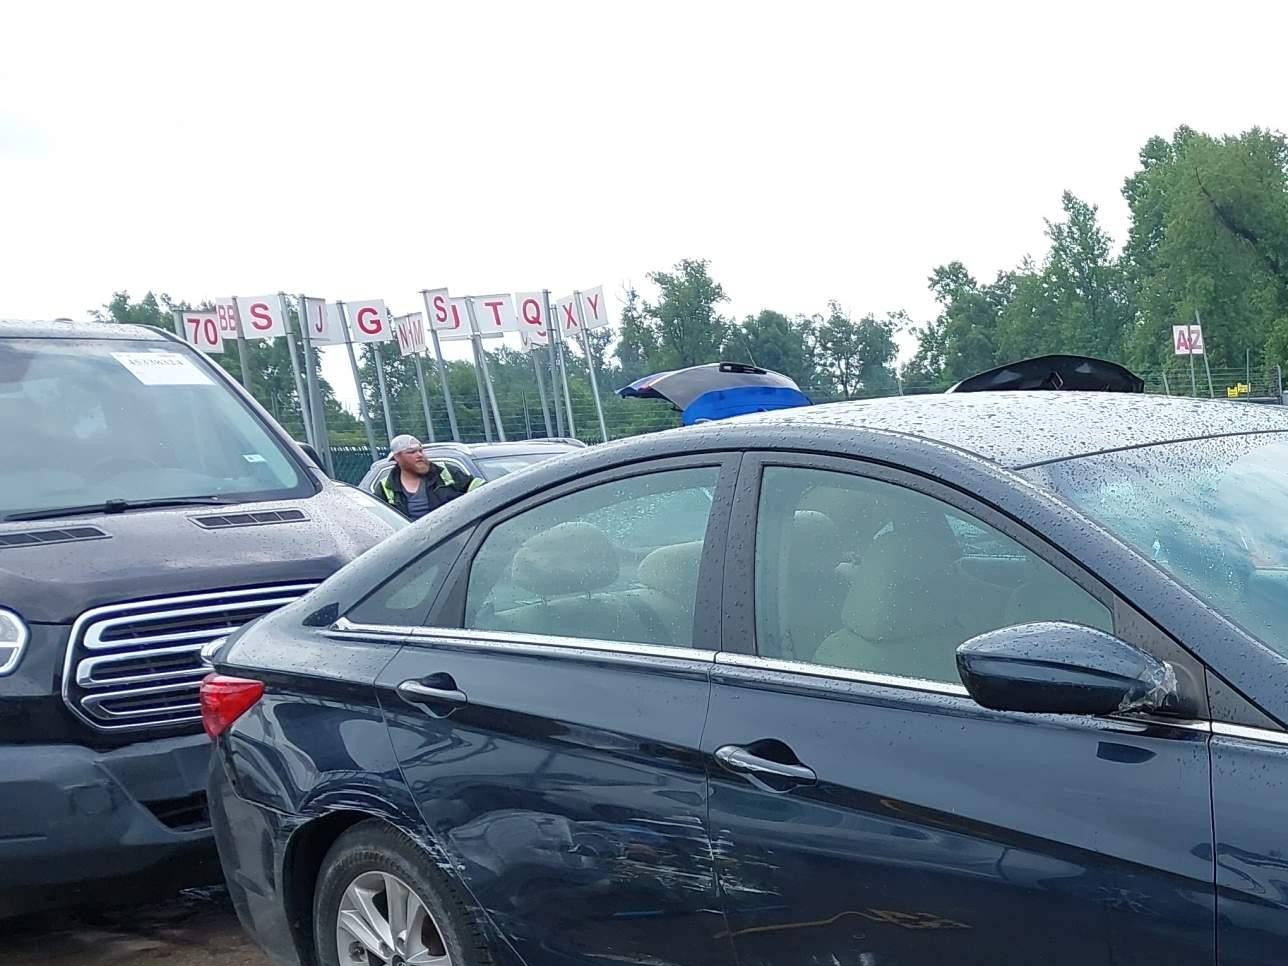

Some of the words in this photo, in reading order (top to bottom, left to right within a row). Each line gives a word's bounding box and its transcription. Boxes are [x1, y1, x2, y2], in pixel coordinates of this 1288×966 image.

[250, 303, 273, 330] S
[316, 305, 323, 332] J
[357, 307, 382, 334] G
[433, 296, 447, 323] S
[484, 301, 504, 326] T
[522, 298, 542, 325] Q
[562, 302, 577, 329] X
[587, 294, 598, 320] Y
[187, 318, 218, 345] 70
